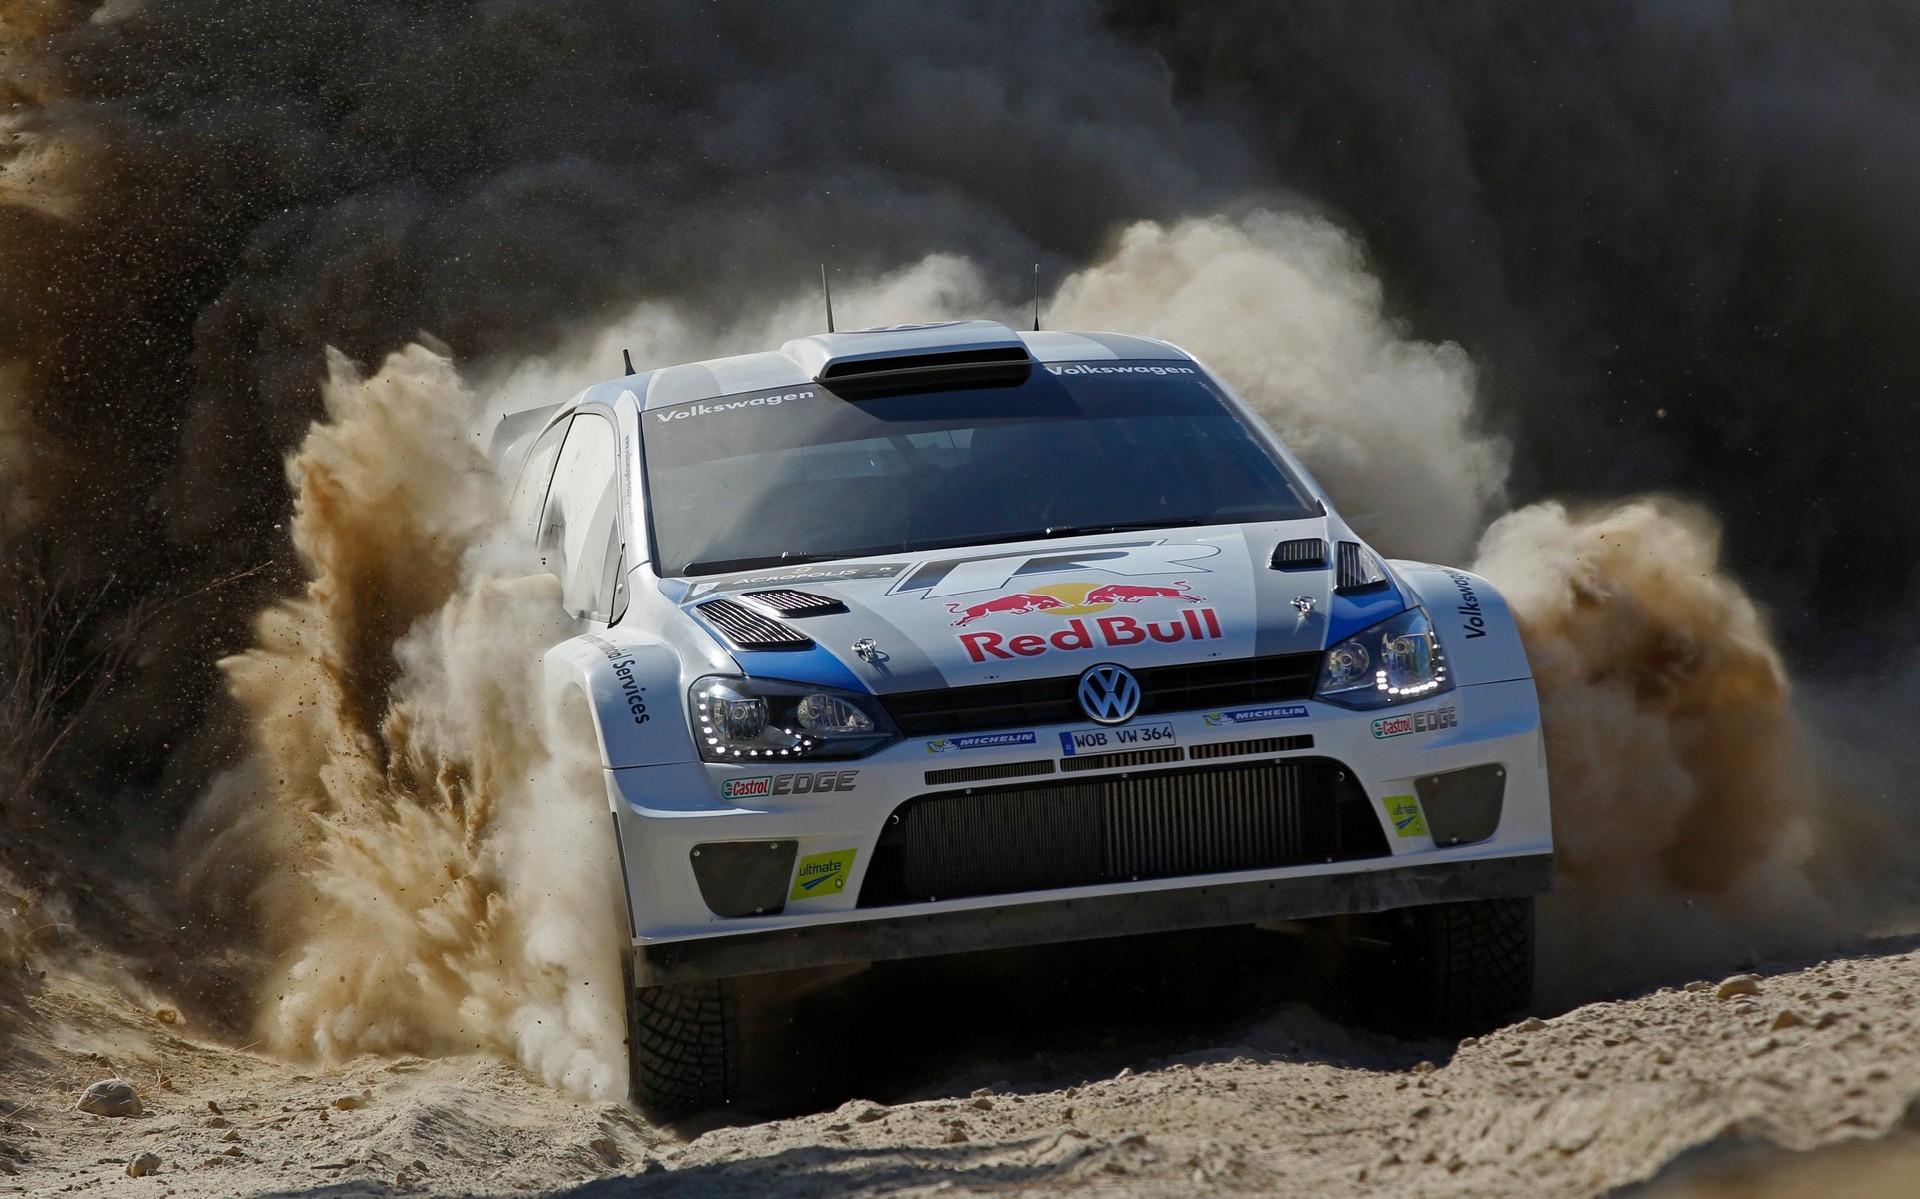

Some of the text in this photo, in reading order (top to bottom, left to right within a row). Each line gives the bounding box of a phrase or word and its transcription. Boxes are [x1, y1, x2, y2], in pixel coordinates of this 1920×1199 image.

[1045, 364, 1195, 376] Volkswagen
[656, 391, 814, 423] Volkswagen
[732, 568, 859, 585] ACROPOLIS
[959, 608, 1222, 663] Red Bull
[612, 659, 650, 724] Services
[1236, 707, 1305, 719] MICHELIN
[1383, 706, 1458, 735] Castrol EDGE
[960, 733, 1033, 746] MICHELIN
[1074, 726, 1172, 748] WOB VW 364
[733, 770, 860, 796] Castrol EDGE
[800, 860, 842, 877] ultimate
